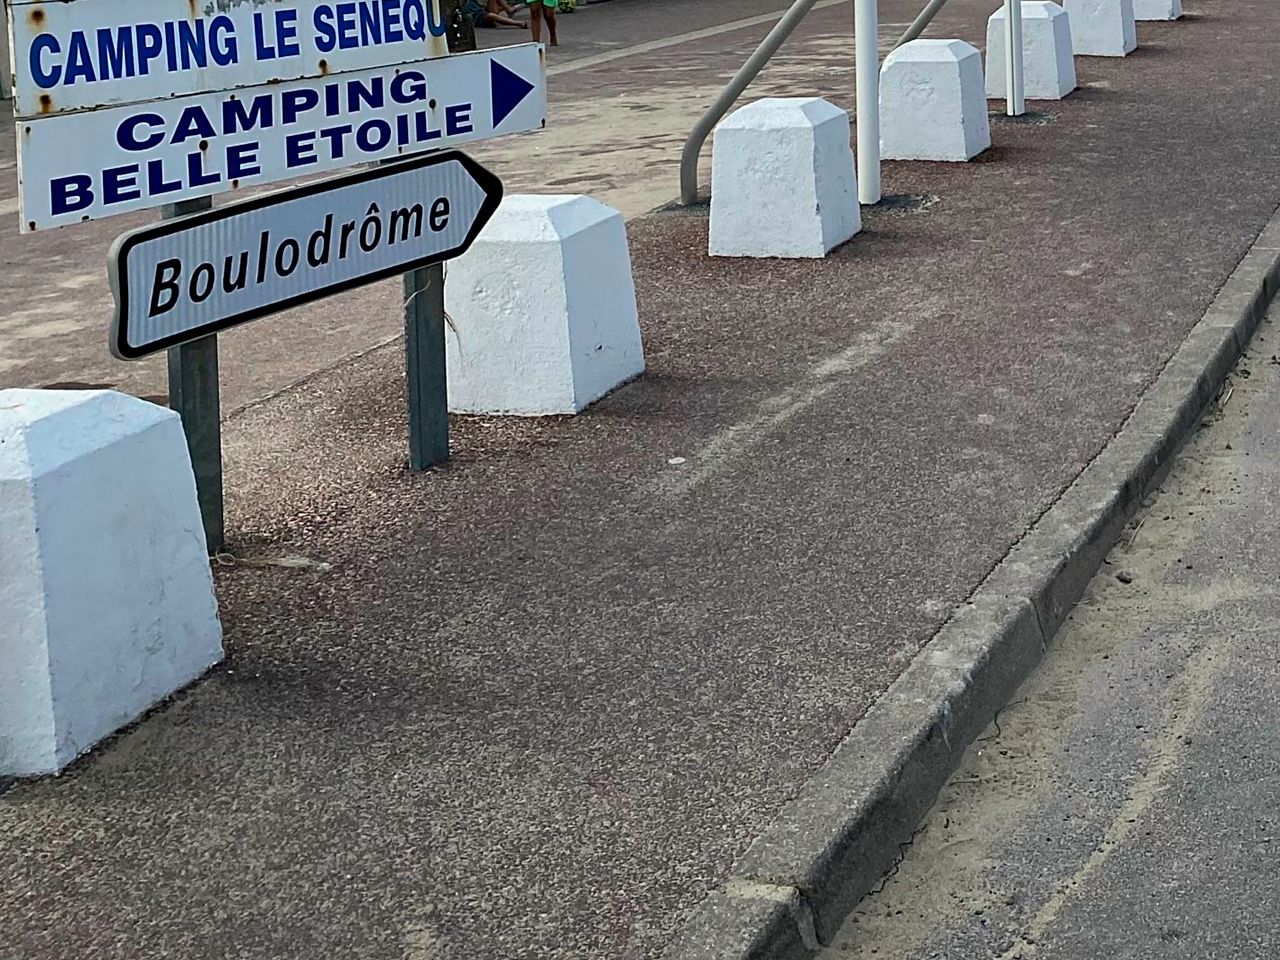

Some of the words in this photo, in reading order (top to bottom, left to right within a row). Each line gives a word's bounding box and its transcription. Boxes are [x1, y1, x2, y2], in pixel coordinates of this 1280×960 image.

[29, 15, 239, 89] CAMPING
[254, 8, 301, 61] LE
[50, 142, 261, 216] BELLE
[286, 103, 474, 169] ETOILE
[116, 71, 428, 152] CAMPING
[148, 196, 452, 319] Boulodrôme
